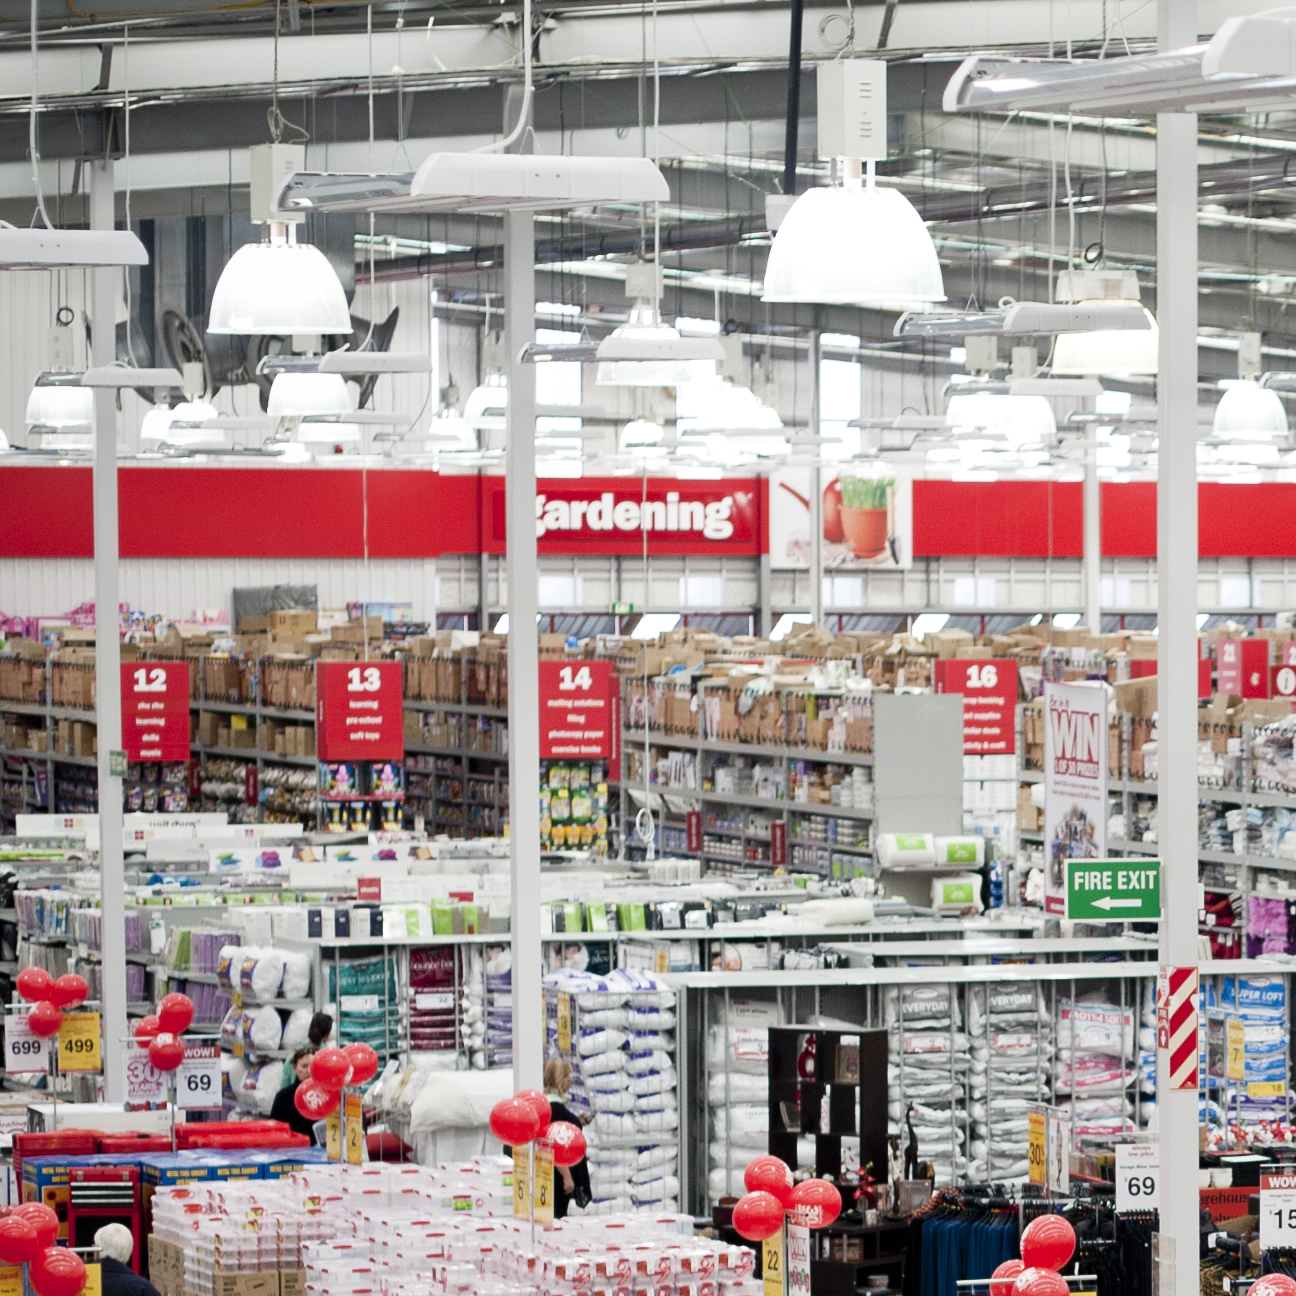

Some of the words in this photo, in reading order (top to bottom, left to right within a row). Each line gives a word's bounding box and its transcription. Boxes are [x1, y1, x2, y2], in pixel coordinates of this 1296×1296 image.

[134, 669, 166, 692] 12
[348, 668, 381, 691] 13
[560, 667, 592, 690] 14
[966, 665, 997, 688] 16
[1051, 710, 1099, 761] WIN
[1074, 872, 1112, 890] FIRE
[1118, 870, 1156, 889] EXIT
[11, 1041, 41, 1054] 699
[184, 1048, 214, 1058] WOW!
